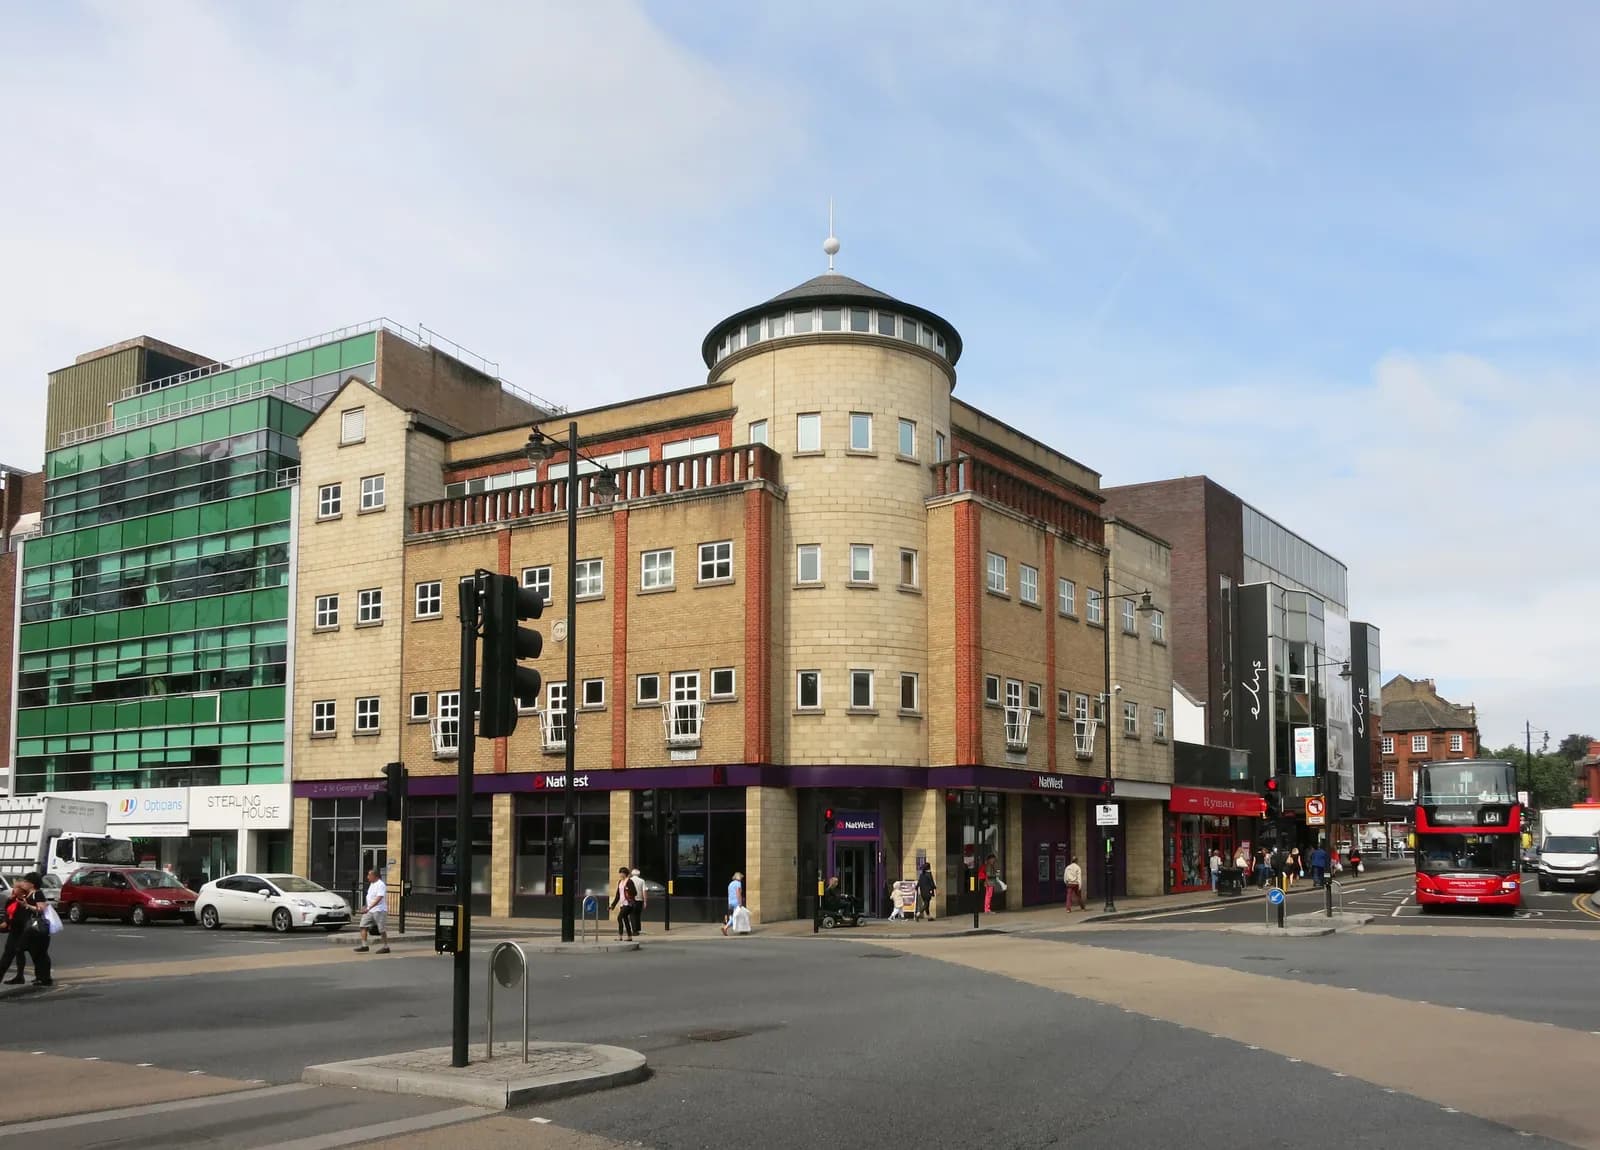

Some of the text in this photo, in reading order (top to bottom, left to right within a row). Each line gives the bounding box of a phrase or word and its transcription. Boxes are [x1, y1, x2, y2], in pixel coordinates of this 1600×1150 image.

[1242, 660, 1267, 721] elys
[1353, 687, 1368, 738] elys
[545, 775, 589, 788] Natest
[1038, 776, 1063, 789] NatWest
[143, 799, 183, 812] Opticians
[207, 795, 261, 808] STERLING
[1203, 796, 1235, 809] Ryman
[242, 806, 279, 819] HOUSE
[845, 821, 875, 829] NatWest
